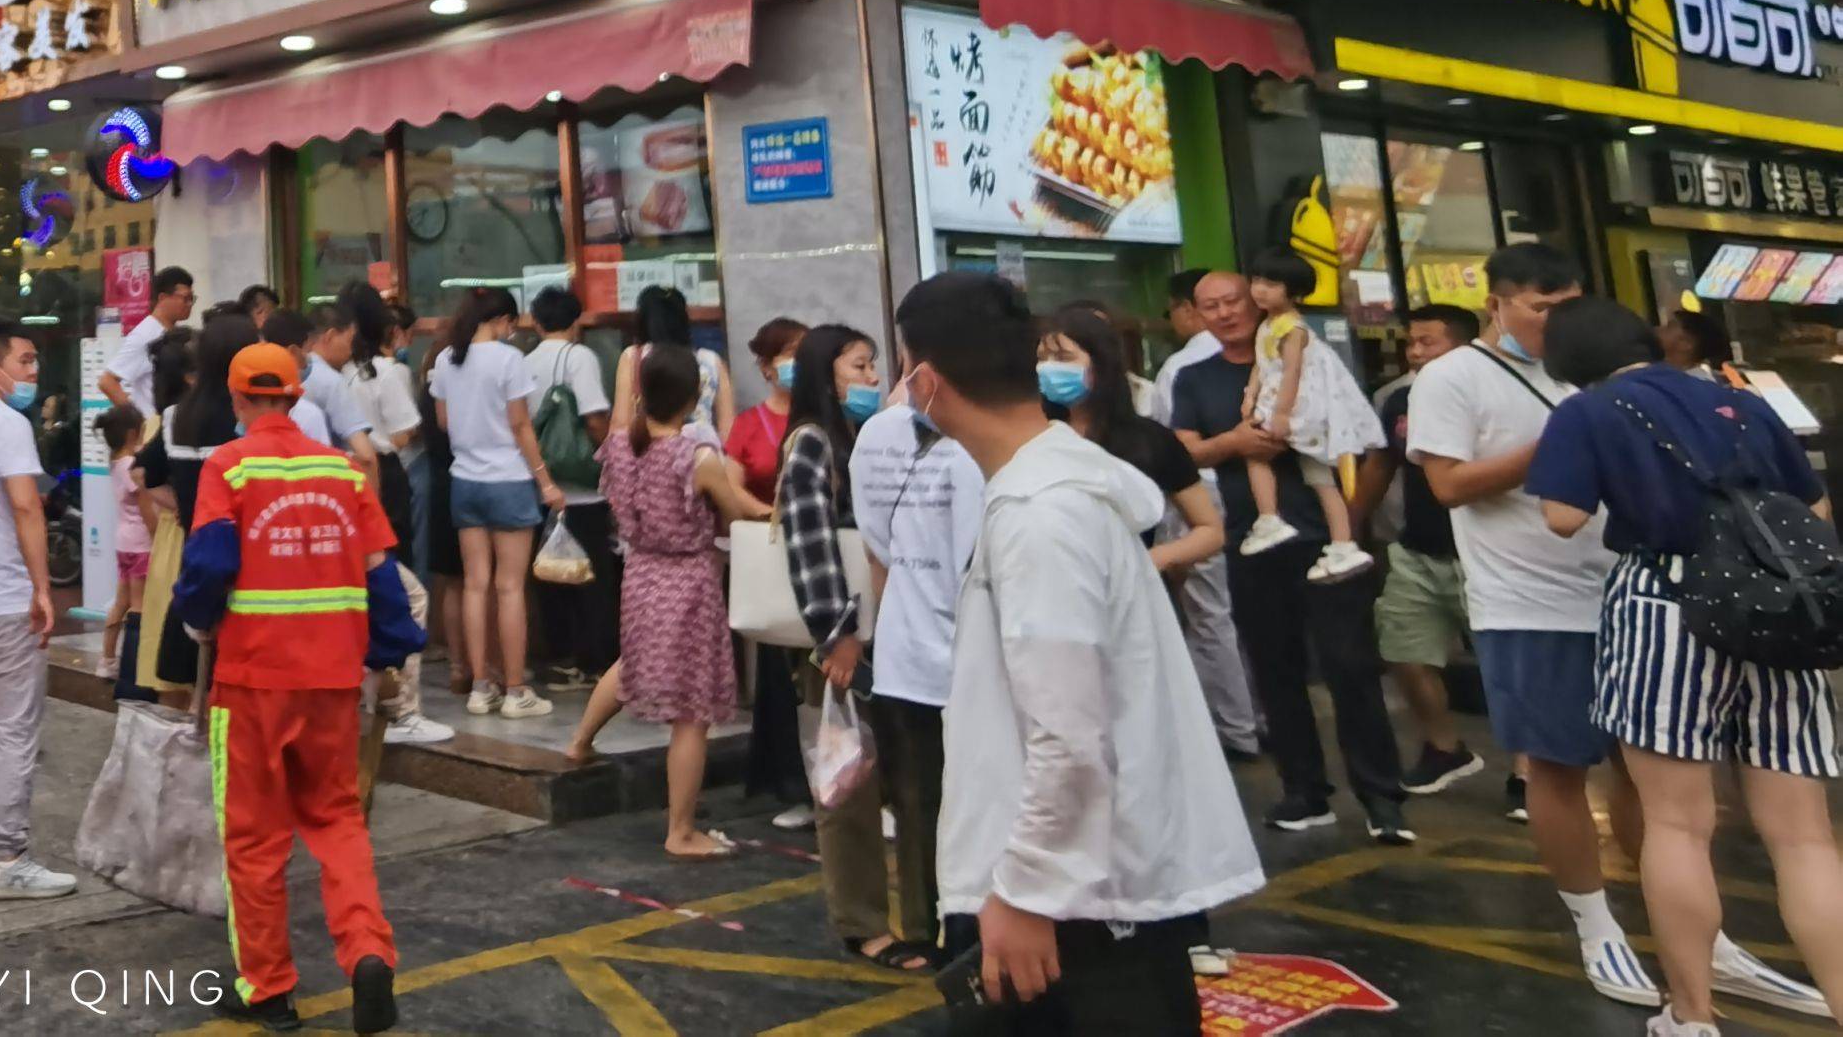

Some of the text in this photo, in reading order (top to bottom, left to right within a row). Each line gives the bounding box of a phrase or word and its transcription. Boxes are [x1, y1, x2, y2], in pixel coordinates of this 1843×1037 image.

[921, 26, 945, 131] 怀远一品
[949, 31, 996, 209] 烤面筋
